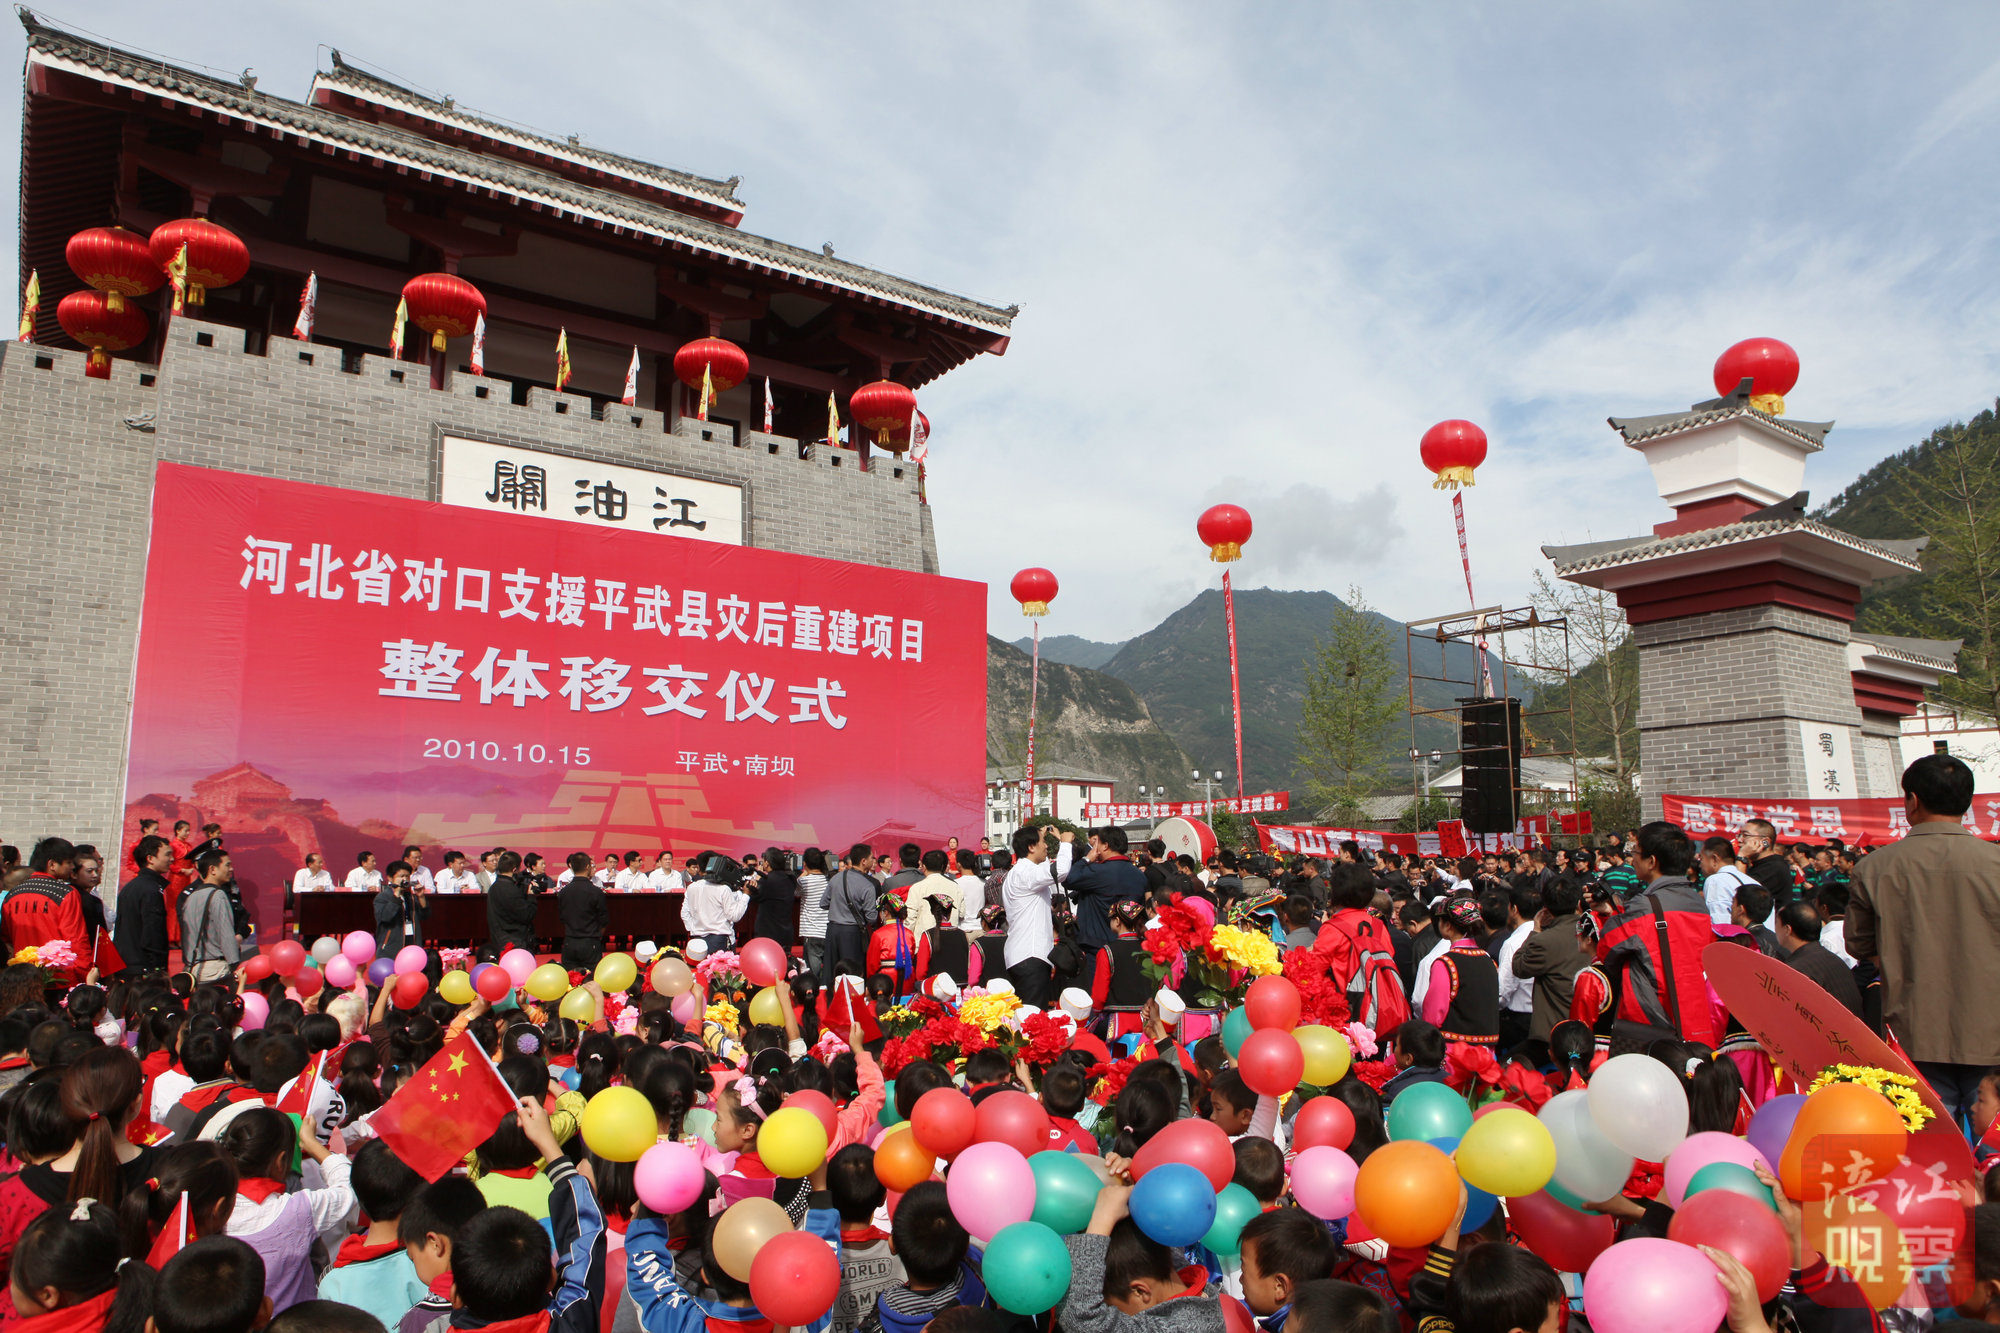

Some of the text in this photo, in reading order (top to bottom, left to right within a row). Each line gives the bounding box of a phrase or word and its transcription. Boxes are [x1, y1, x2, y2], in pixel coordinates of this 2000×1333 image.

[239, 534, 923, 663] 河北省对口支援平武县灾后重建项目
[378, 638, 848, 730] 整体移交仪式
[423, 738, 796, 777] 2010.10.15 平武·南坝
